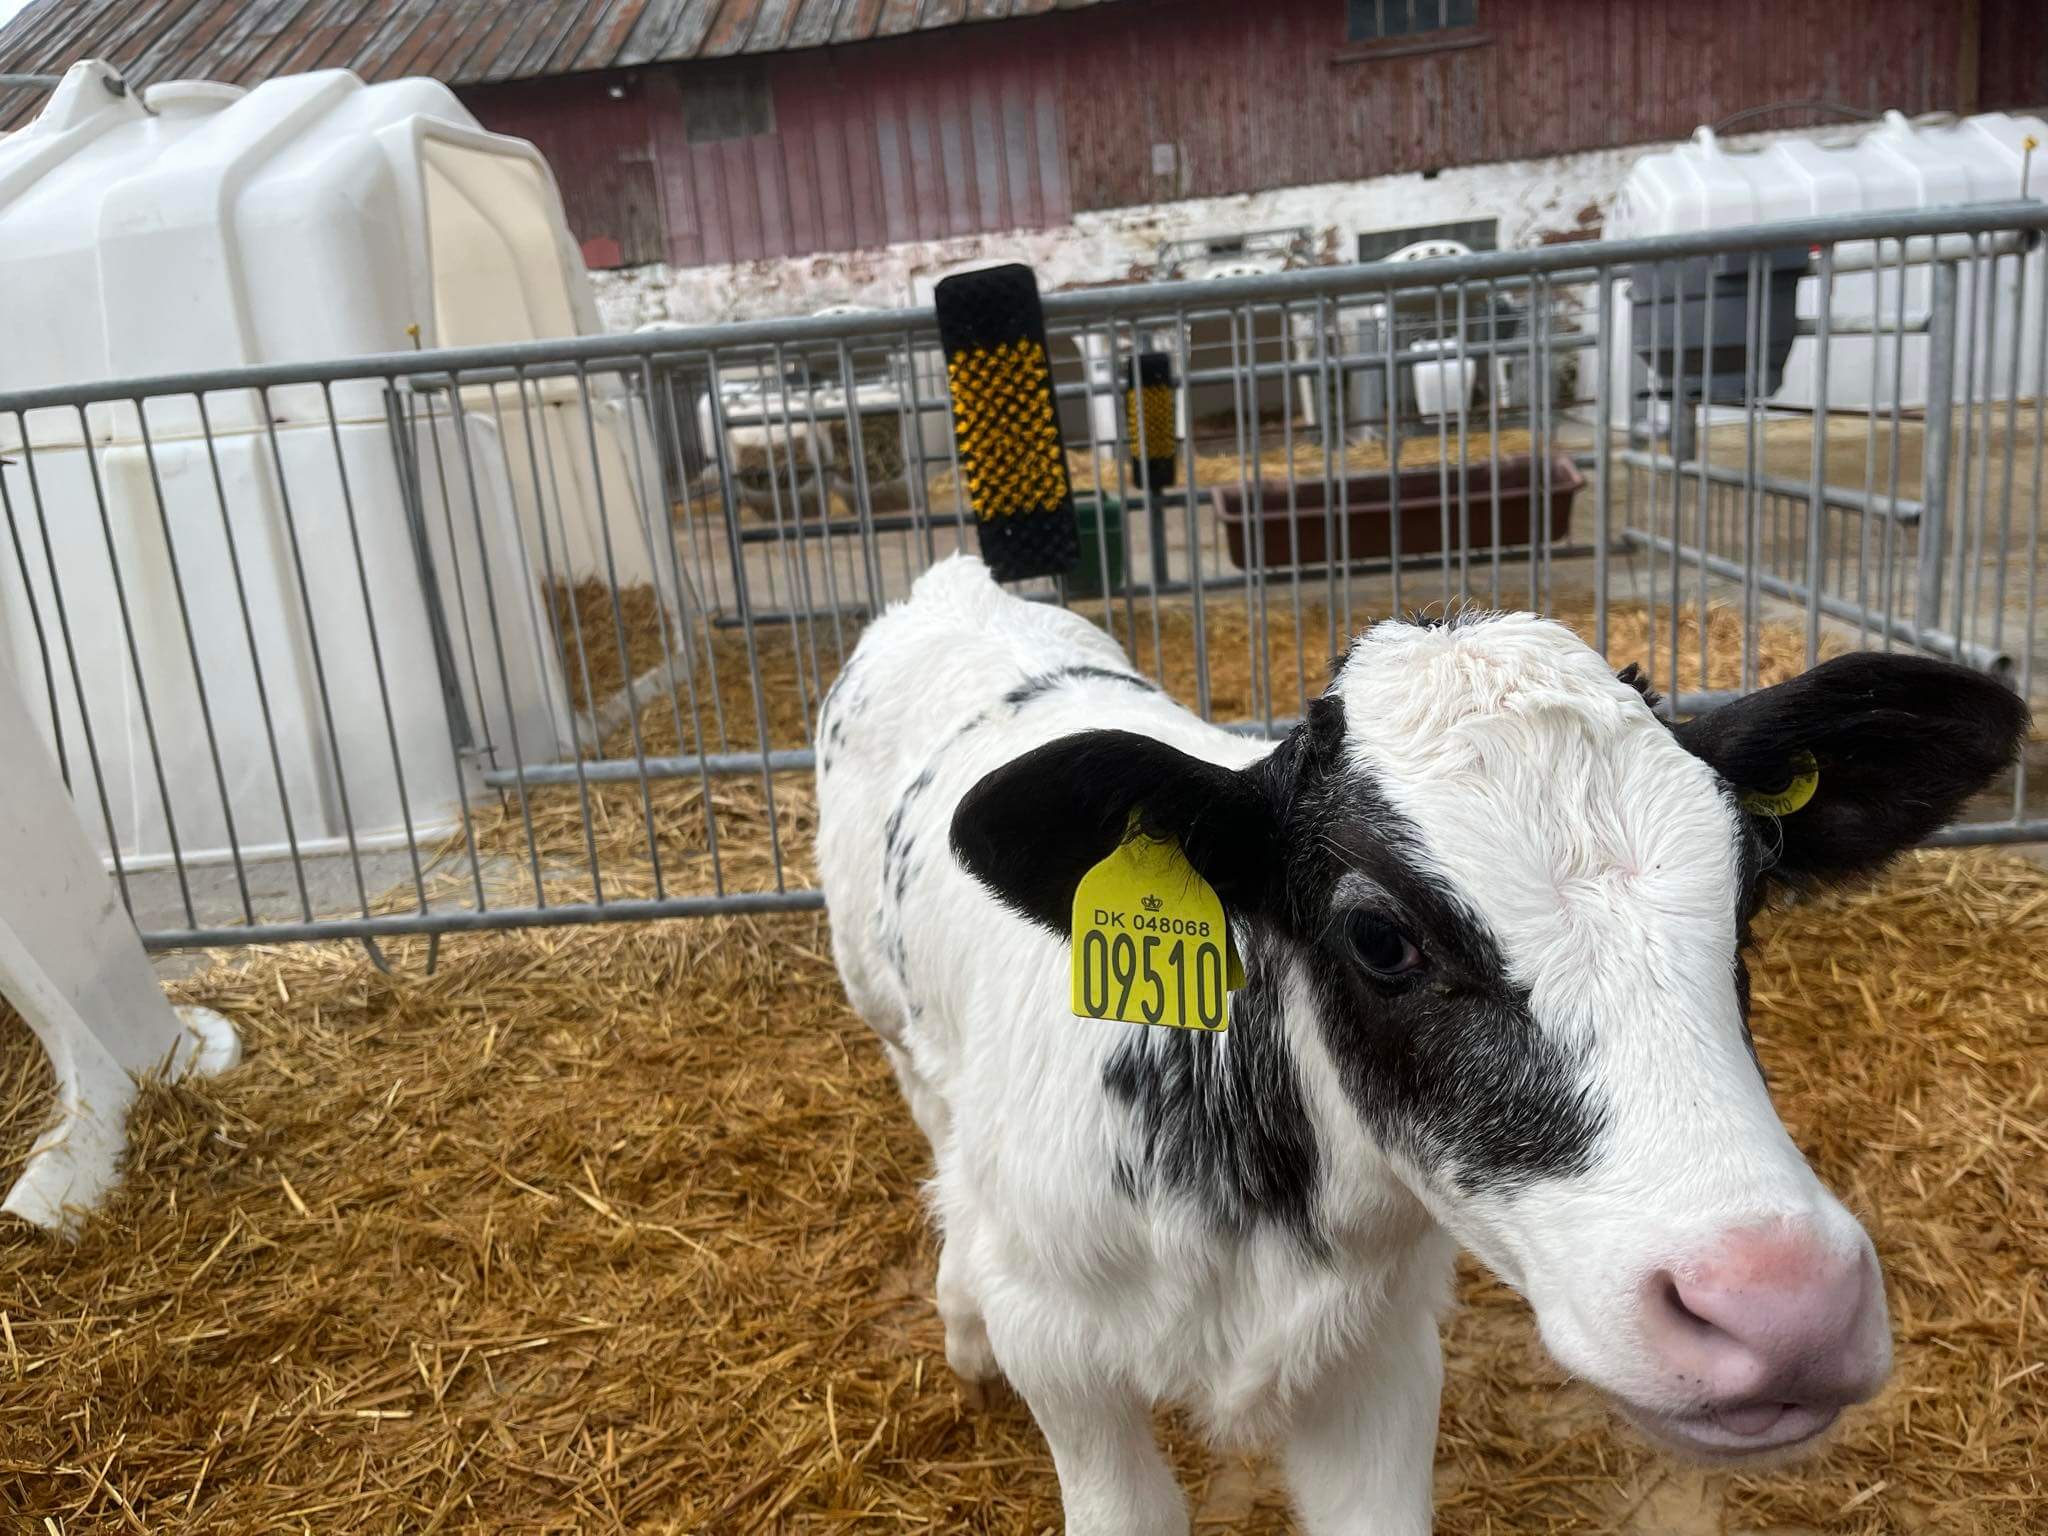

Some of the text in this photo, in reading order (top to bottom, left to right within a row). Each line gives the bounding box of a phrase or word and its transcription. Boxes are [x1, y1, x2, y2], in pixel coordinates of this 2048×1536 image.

[1094, 909, 1210, 937] DK 048068
[1083, 929, 1223, 1029] 09510
